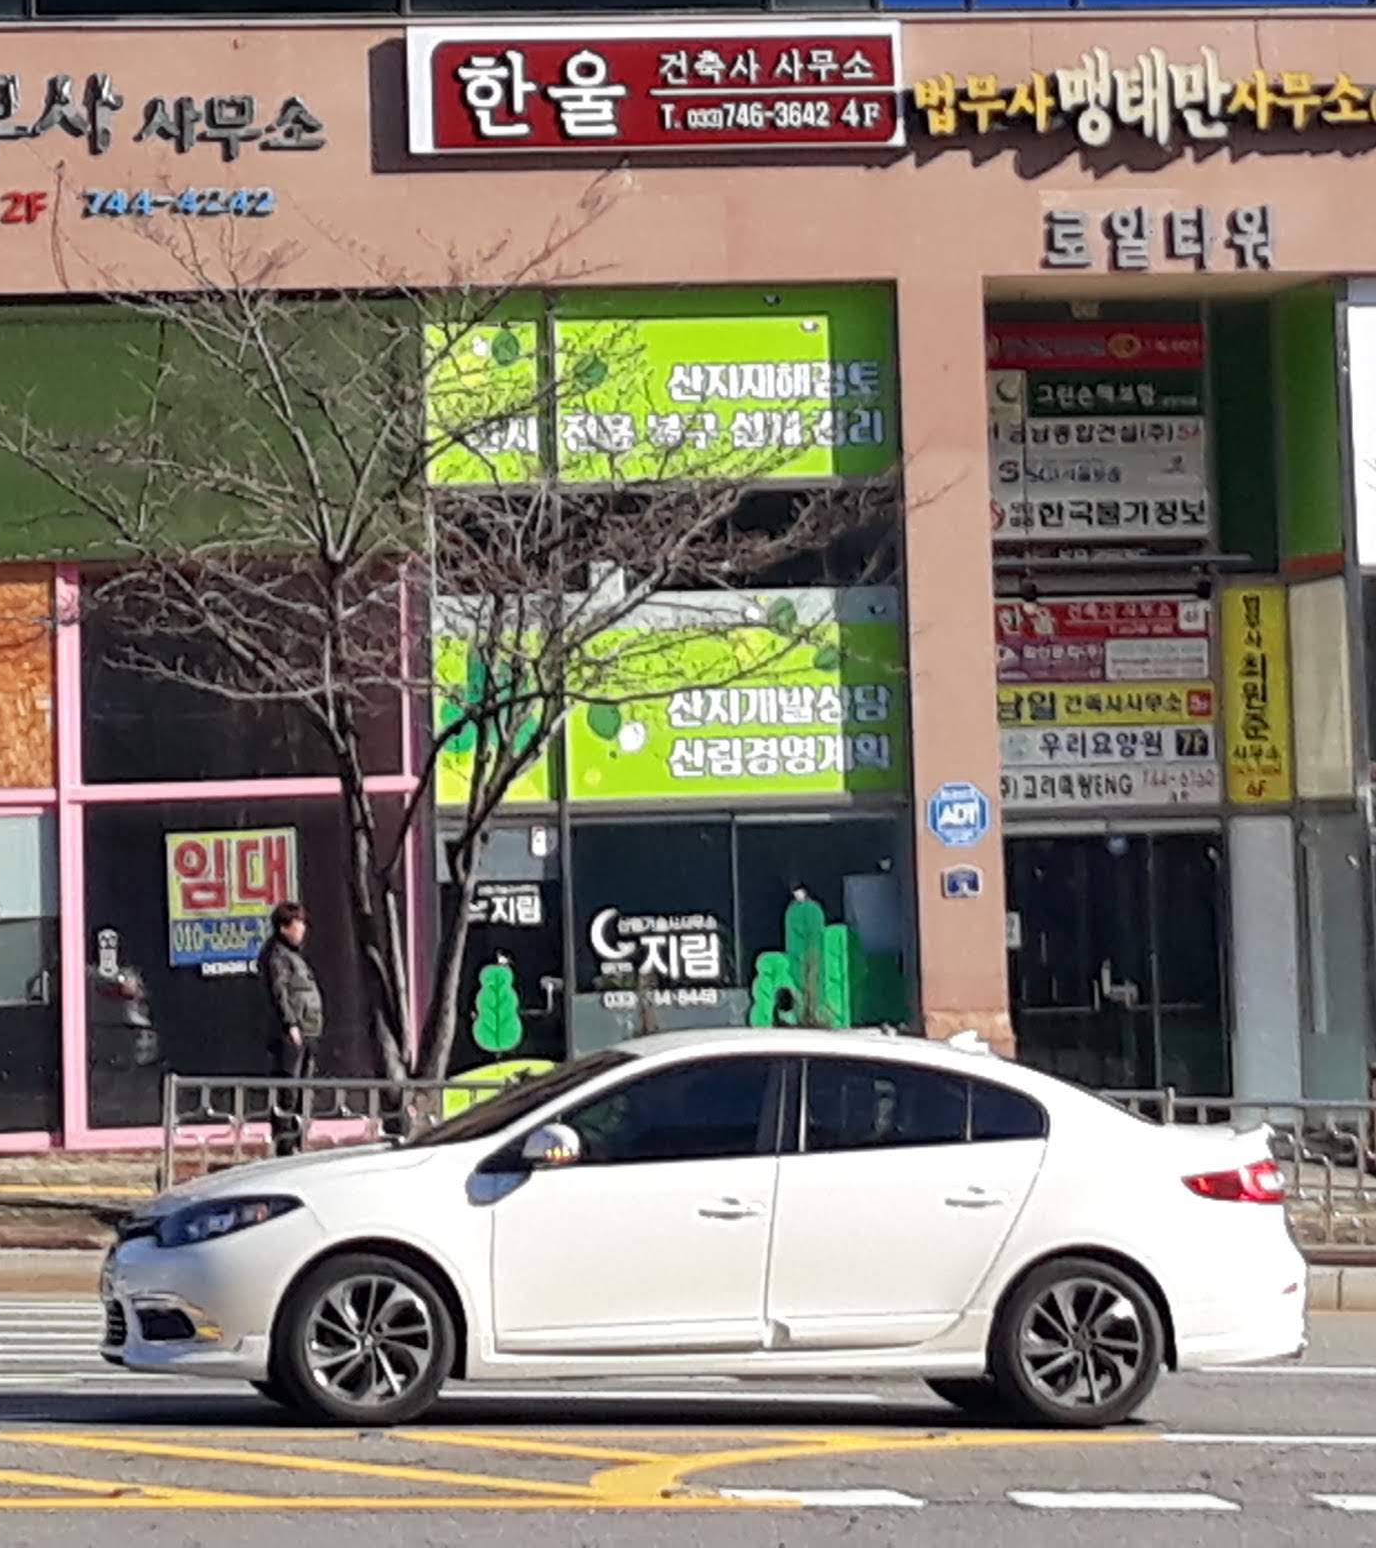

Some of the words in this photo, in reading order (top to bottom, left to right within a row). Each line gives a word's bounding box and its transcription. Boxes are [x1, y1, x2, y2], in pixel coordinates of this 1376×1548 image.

[659, 48, 761, 86] 건축사
[774, 47, 876, 83] 사무소
[457, 49, 628, 140] 한울
[840, 97, 881, 128] 4F
[138, 94, 328, 152] 사무소
[0, 189, 50, 226] 2F
[173, 835, 287, 910] 임대
[638, 932, 721, 981] 지림
